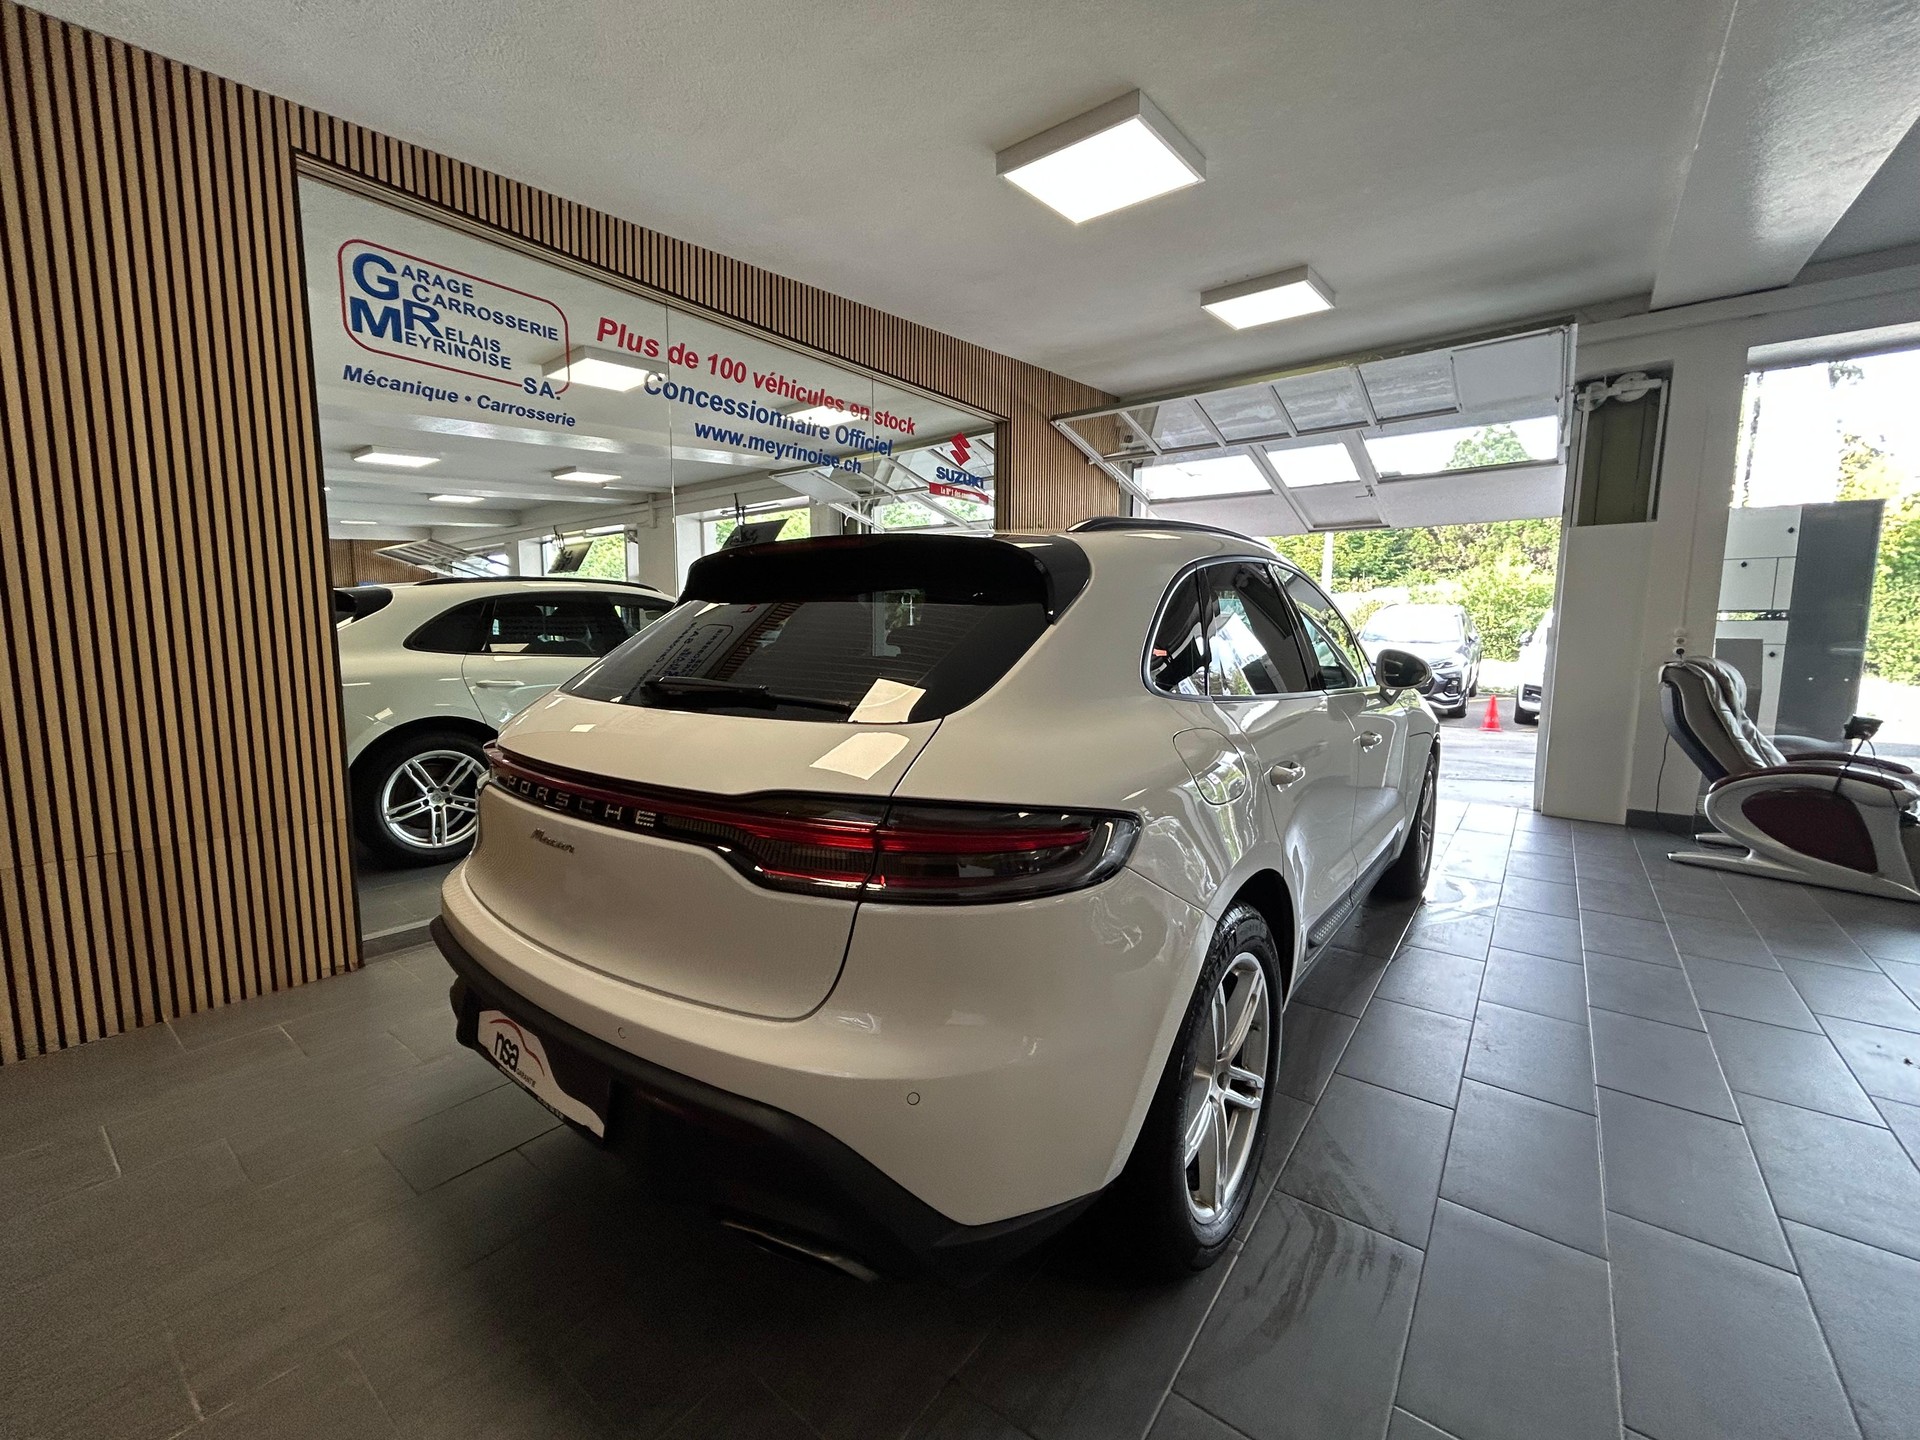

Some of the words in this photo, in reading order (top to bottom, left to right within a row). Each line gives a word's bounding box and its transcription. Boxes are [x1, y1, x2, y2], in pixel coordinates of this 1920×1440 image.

[352, 252, 474, 299] GARAGE
[349, 296, 512, 370] MEYRINOISE
[402, 298, 501, 353] RELAIS
[412, 283, 559, 341] CARROSSERIE
[343, 364, 459, 403] Mécanique
[477, 394, 576, 427] Carrosserie
[596, 316, 660, 358] Plus
[668, 342, 699, 369] de
[707, 353, 747, 384] 100
[753, 371, 845, 413] véhicules
[850, 402, 870, 422] en
[874, 410, 916, 436] stock
[644, 370, 830, 441] Concessionnaire
[835, 425, 893, 457] Officiel
[695, 422, 862, 474] www.meyrinoise.ch
[935, 466, 984, 490] SUZUKI
[507, 775, 657, 828] PORSCHE
